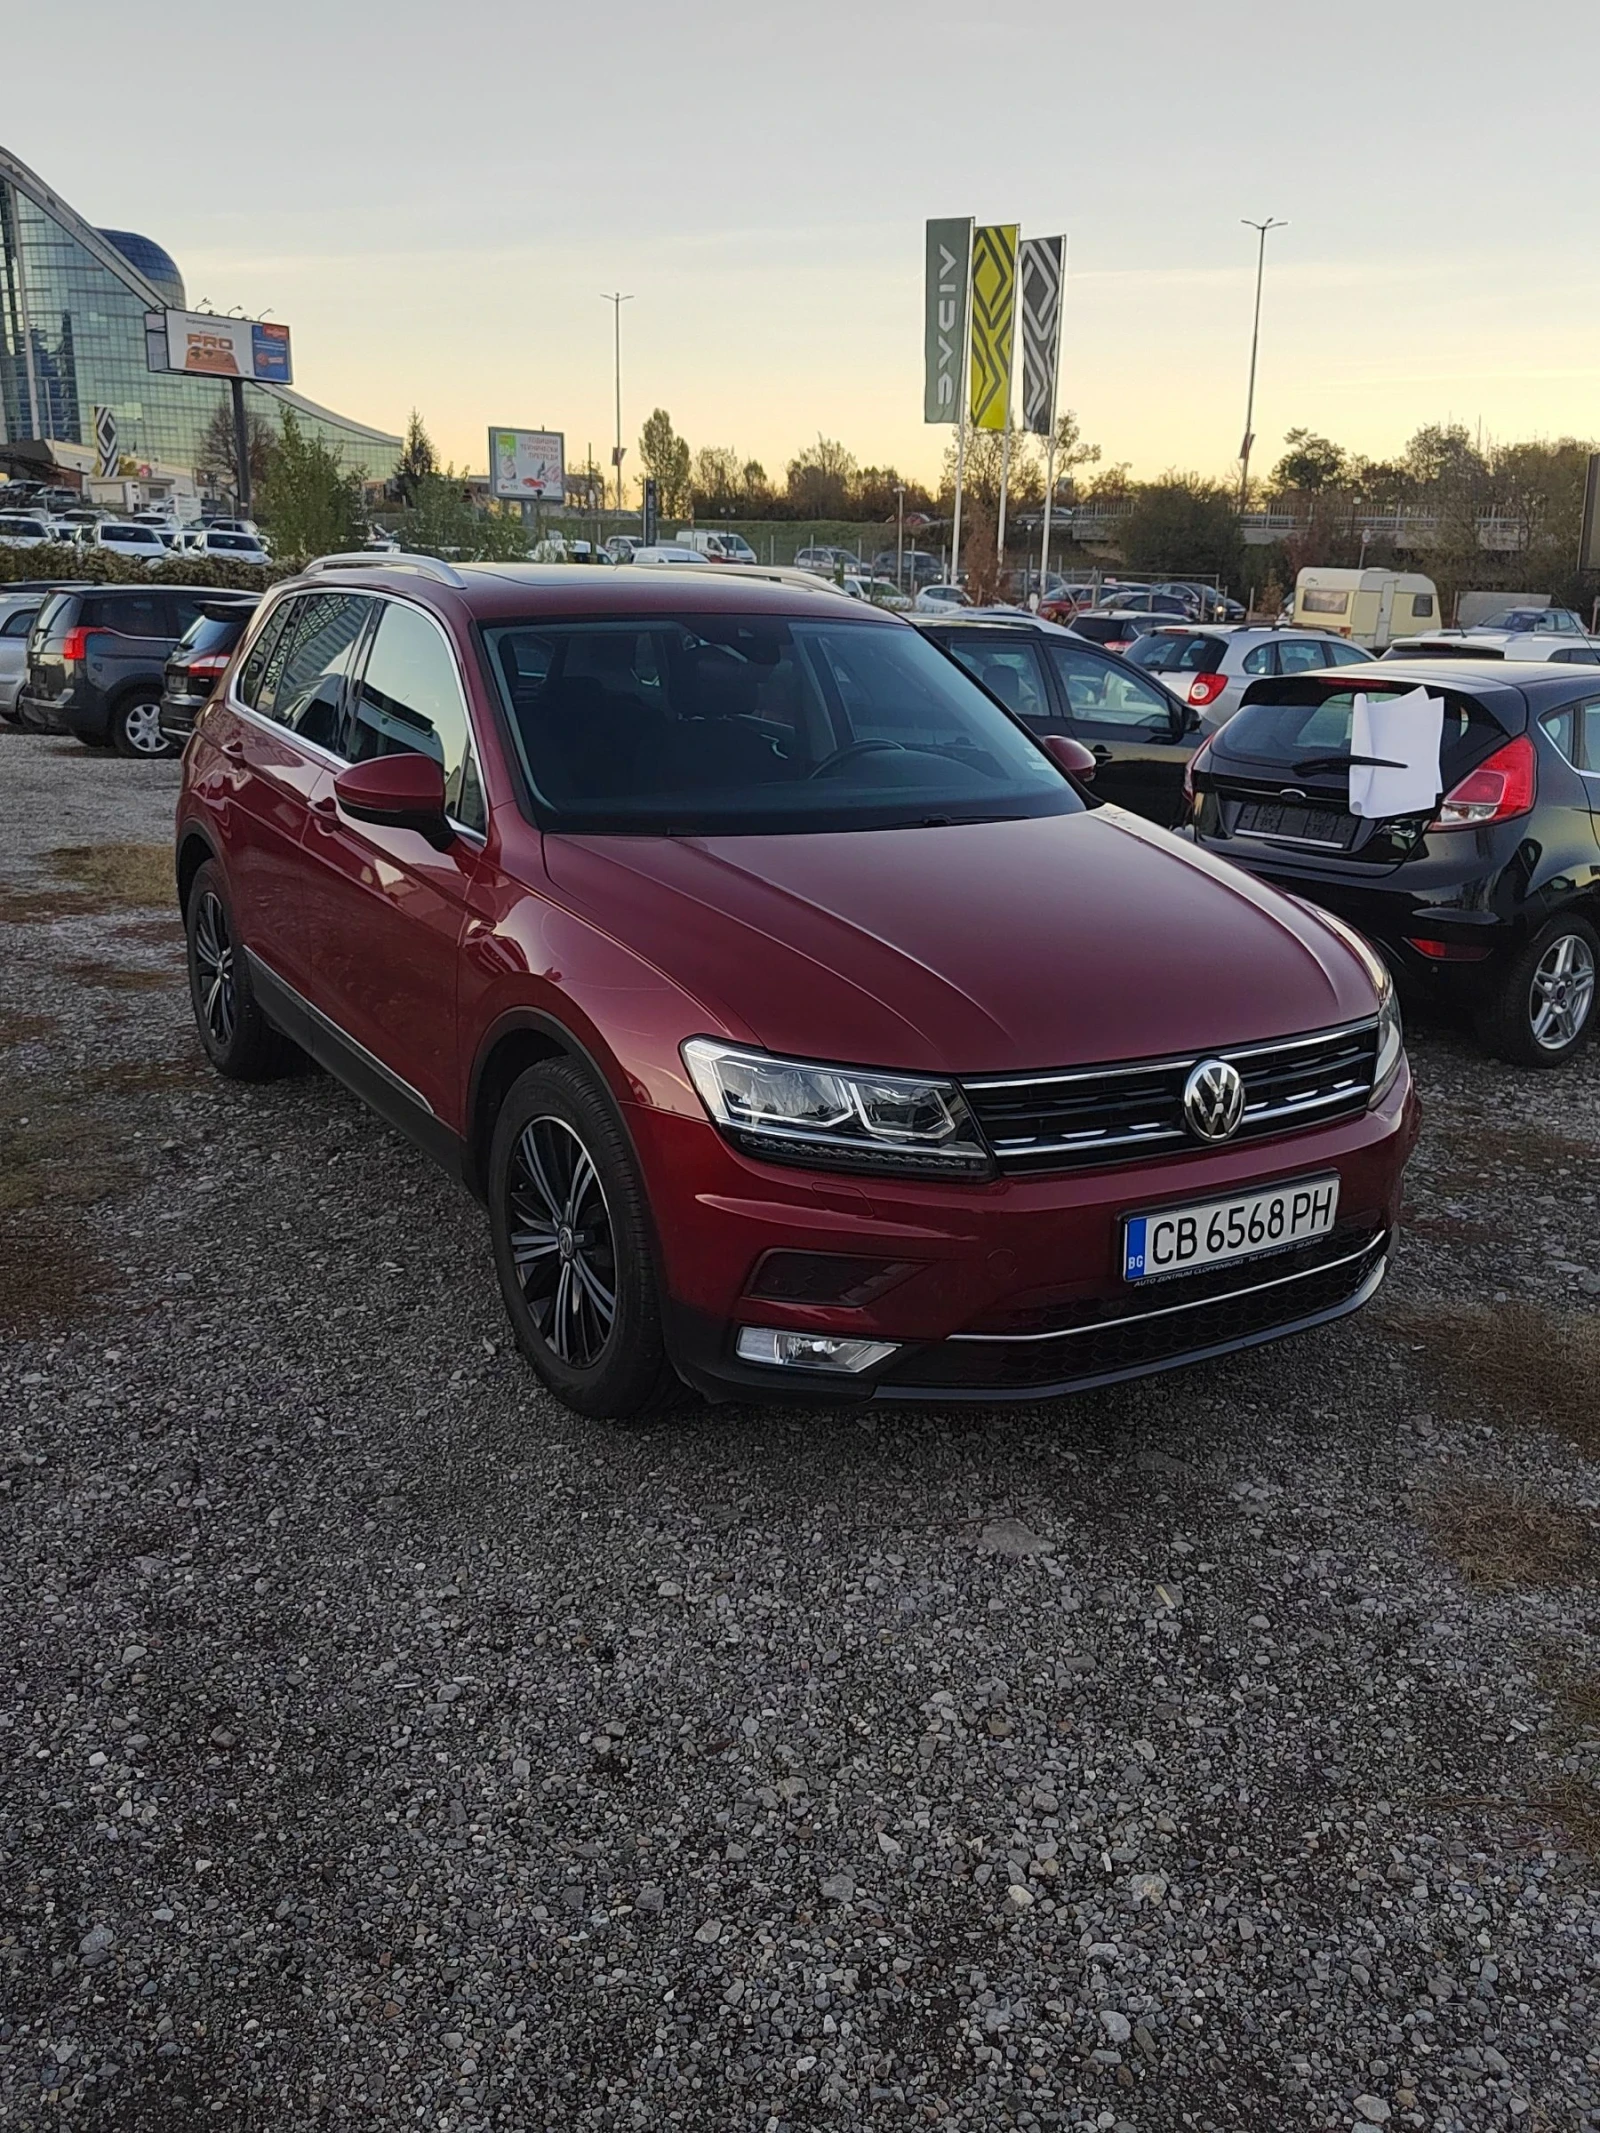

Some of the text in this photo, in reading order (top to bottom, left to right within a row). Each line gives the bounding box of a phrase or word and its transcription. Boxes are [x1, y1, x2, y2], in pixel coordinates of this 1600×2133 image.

[187, 333, 233, 350] PRO
[1153, 1186, 1333, 1265] CB 6568 PH
[1128, 1255, 1144, 1270] BG
[1133, 1277, 1156, 1287] AUTO
[1157, 1270, 1193, 1283] ZENTRUM
